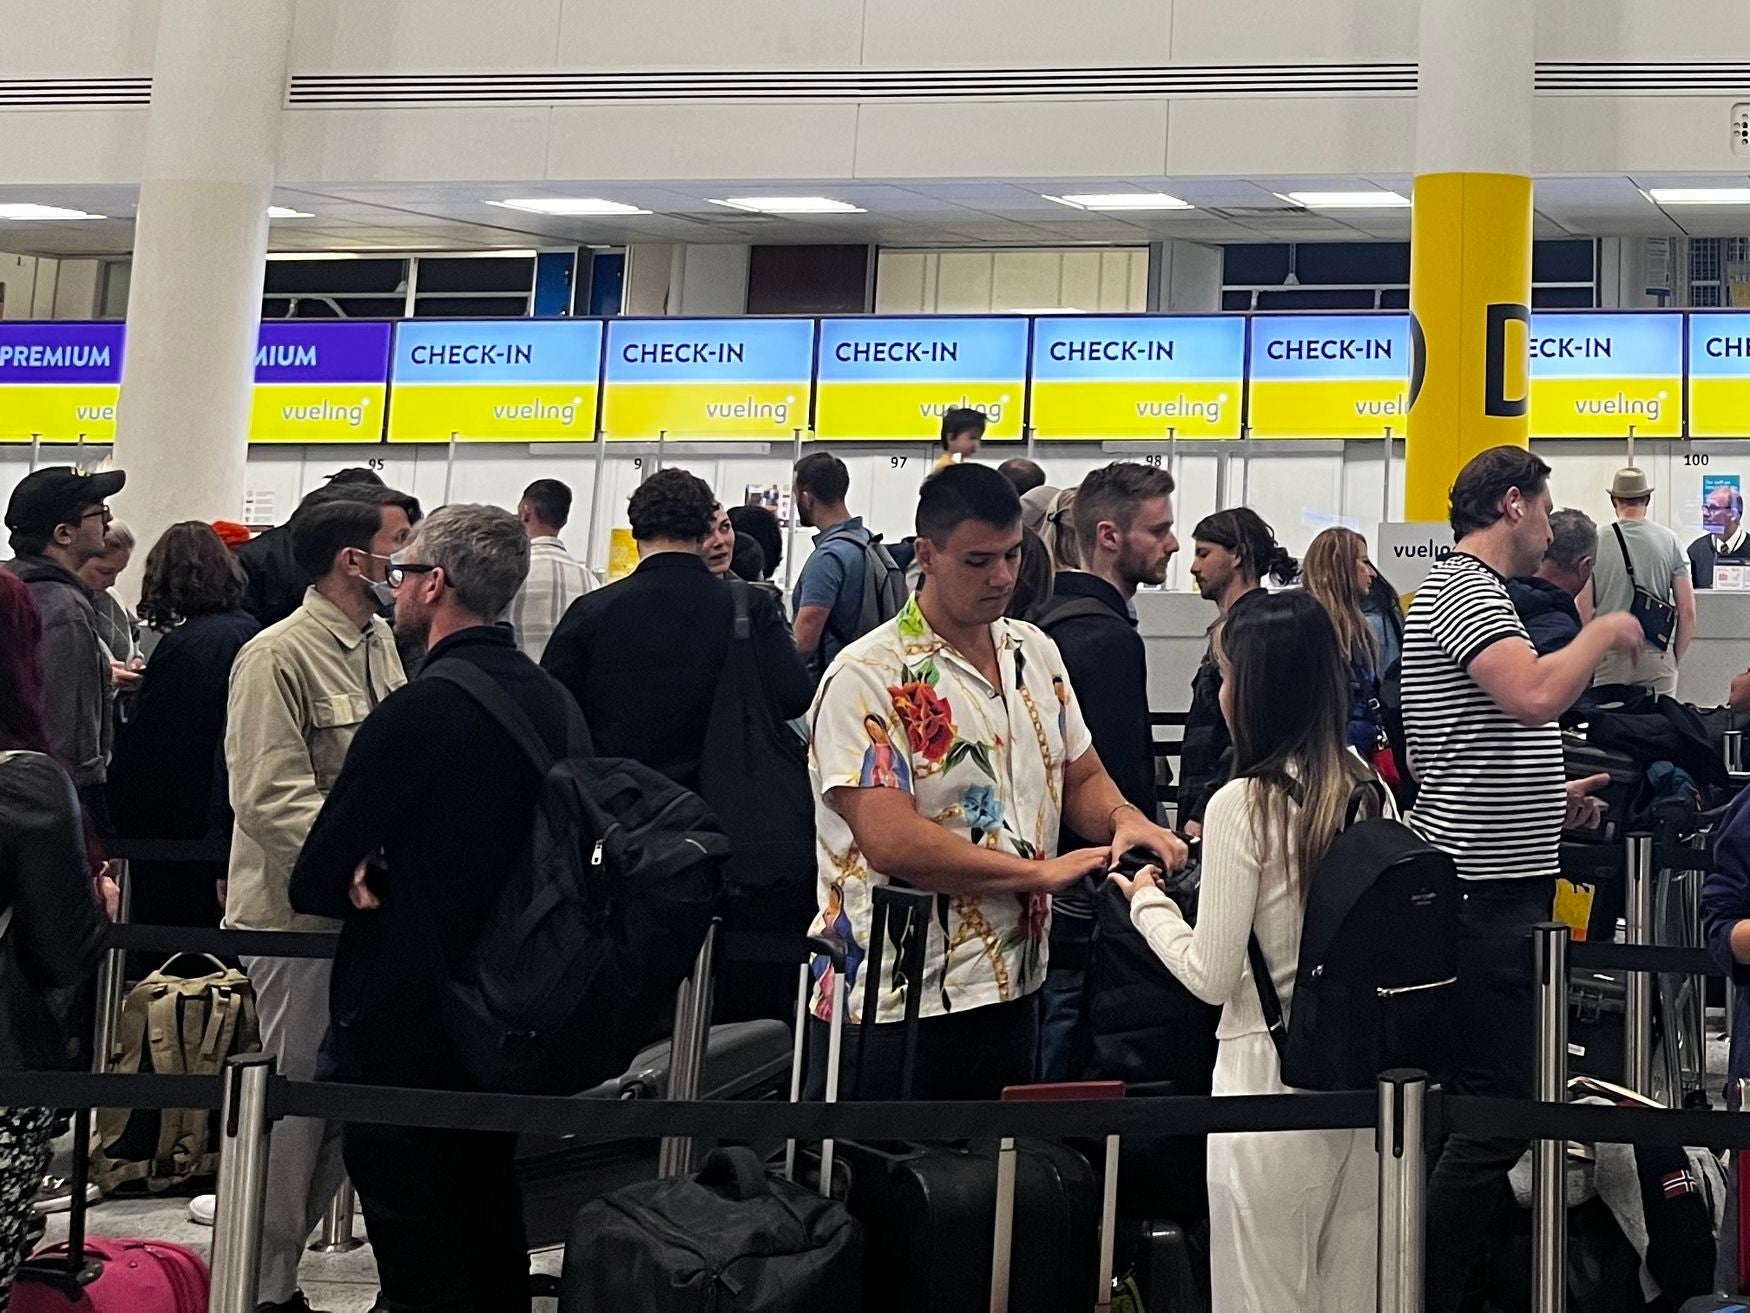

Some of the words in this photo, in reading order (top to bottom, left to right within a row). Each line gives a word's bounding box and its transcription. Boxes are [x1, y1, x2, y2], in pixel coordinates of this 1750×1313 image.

[0, 345, 111, 367] PREMIUM
[254, 345, 317, 367] MIUM
[411, 345, 532, 365] CHECK-IN
[623, 343, 744, 364] CHECK-IN
[835, 342, 958, 363] CHECK-IN
[1050, 341, 1174, 362] CHECK-IN
[1267, 338, 1392, 361] CHECK-IN
[1528, 338, 1612, 359] ECK-IN
[282, 400, 362, 427] vueling
[494, 398, 574, 426] vueling
[706, 396, 787, 424] vueling
[1136, 394, 1219, 423] vueling
[1575, 392, 1659, 421] vueling
[368, 458, 385, 471] 95
[890, 456, 908, 469] 97
[1146, 455, 1162, 467] 98
[1684, 454, 1710, 467] 100
